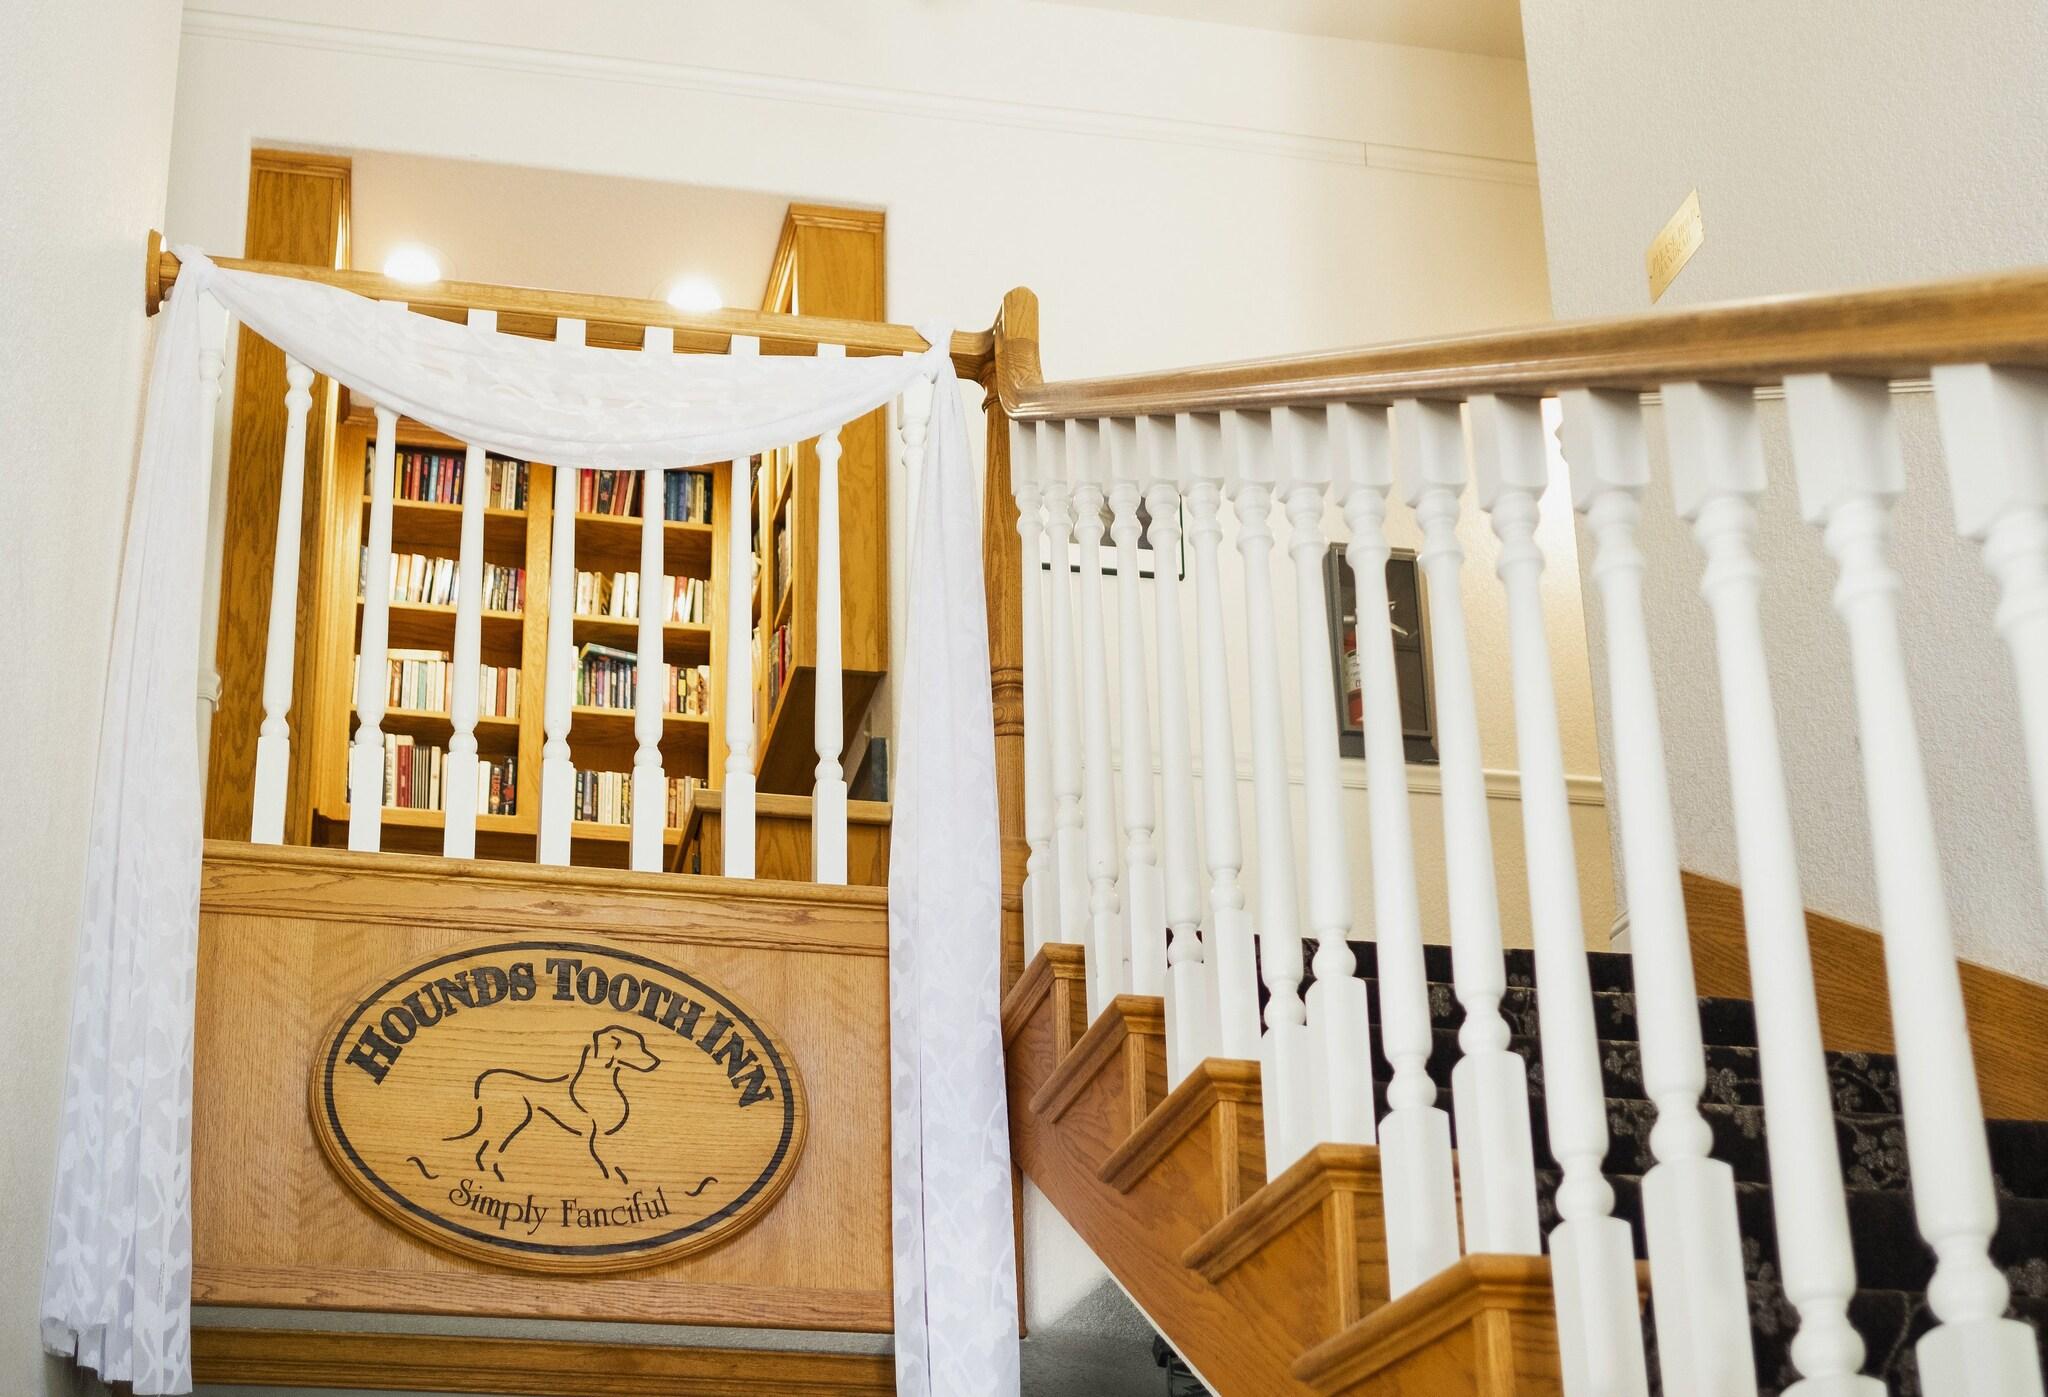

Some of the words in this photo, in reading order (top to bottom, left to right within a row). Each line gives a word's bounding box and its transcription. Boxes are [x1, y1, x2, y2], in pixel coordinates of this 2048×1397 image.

[345, 961, 537, 1085] HOUNDS
[545, 958, 706, 1041] TOOTH
[695, 1010, 775, 1108] INN
[448, 1179, 549, 1236] Simply
[560, 1186, 672, 1228] Fanciful
